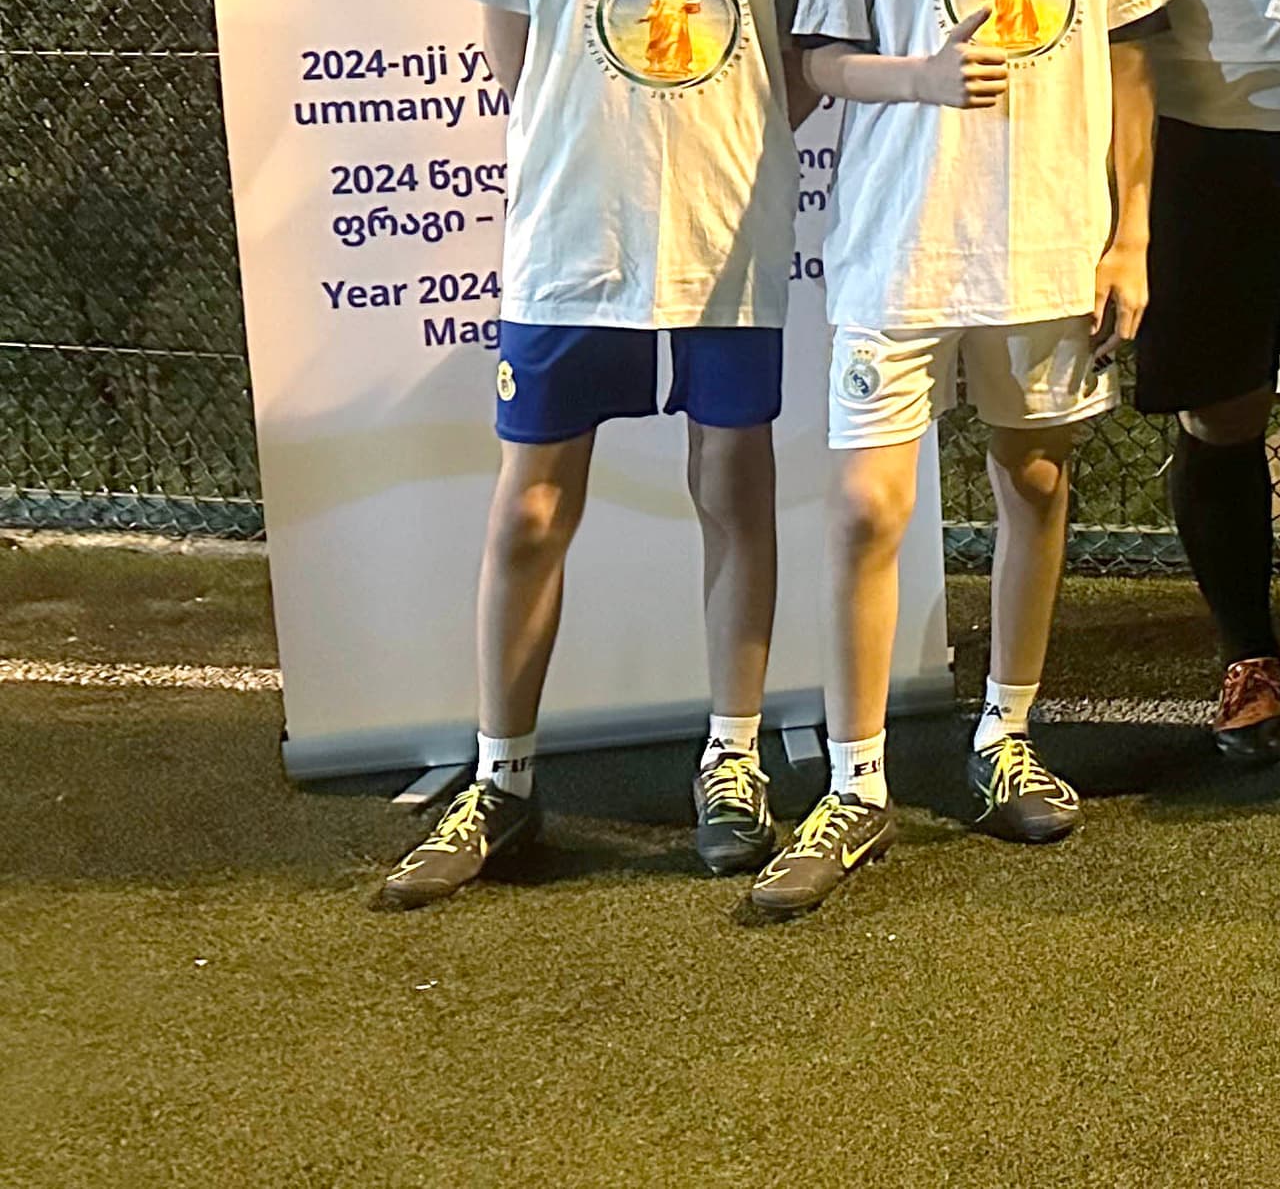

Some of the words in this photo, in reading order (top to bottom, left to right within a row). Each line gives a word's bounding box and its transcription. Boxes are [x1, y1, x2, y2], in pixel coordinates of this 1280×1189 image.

[301, 48, 450, 86] 2024-nji
[293, 93, 466, 128] ummany
[330, 163, 420, 195] 2024
[321, 279, 409, 310] Year
[417, 270, 502, 304] 2024
